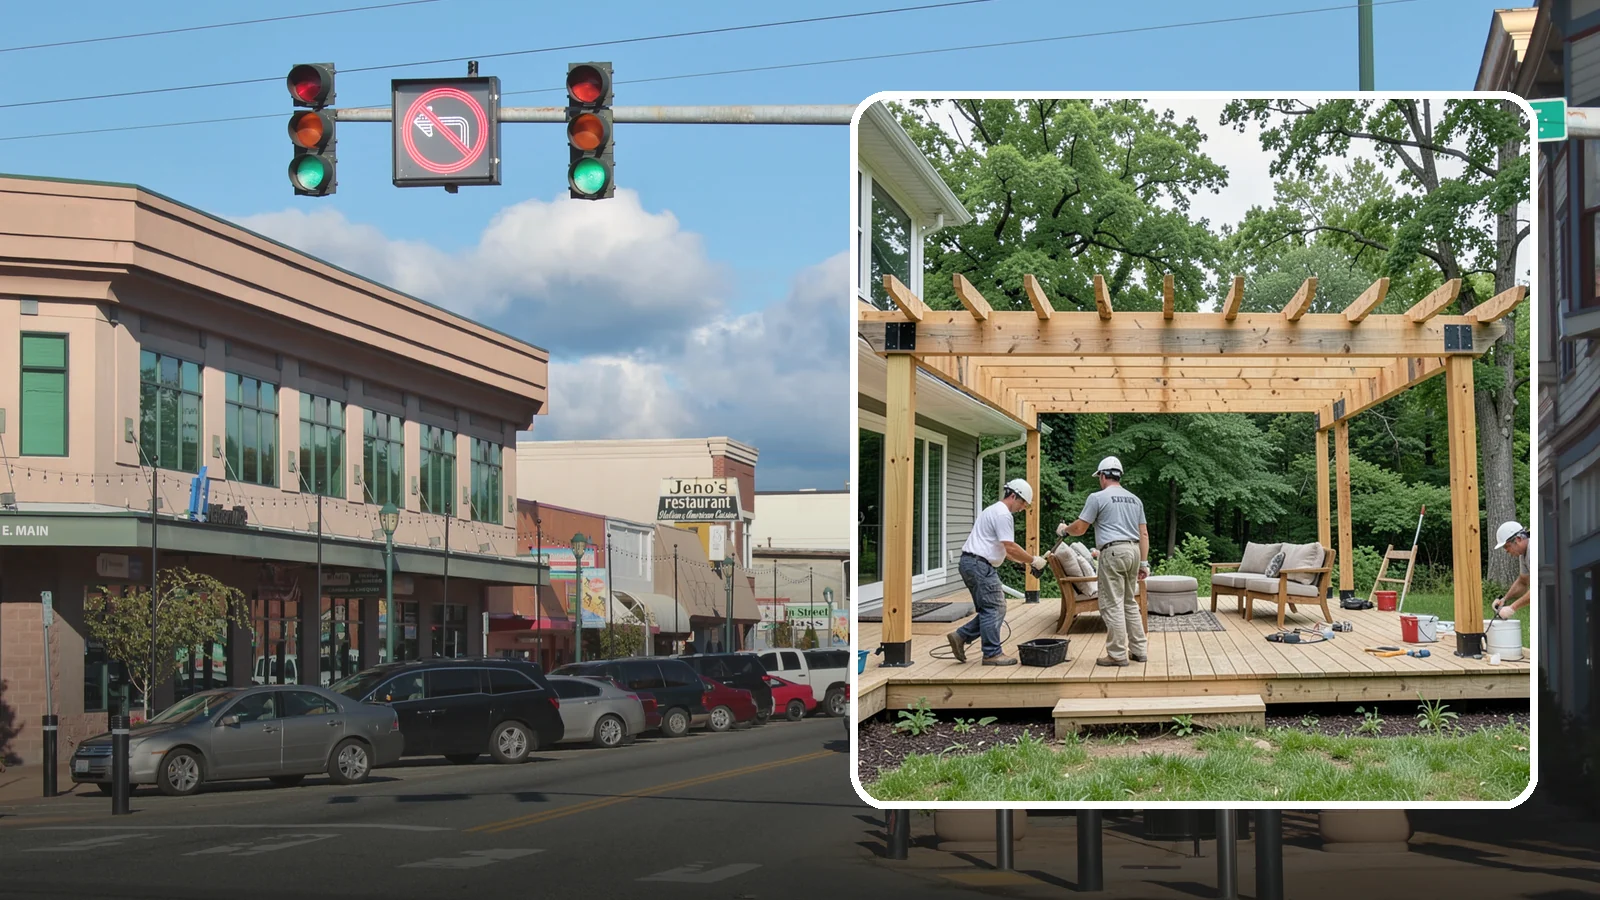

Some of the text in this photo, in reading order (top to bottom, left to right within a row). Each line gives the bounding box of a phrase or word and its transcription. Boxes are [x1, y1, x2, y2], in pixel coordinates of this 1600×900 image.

[669, 480, 728, 495] Jeno's
[665, 496, 731, 509] restaurant
[658, 509, 681, 520] Italian
[685, 509, 715, 520] American
[714, 509, 738, 520] Cuisine
[2, 525, 49, 536] E. MAIN
[797, 607, 828, 617] Street
[790, 618, 824, 627] lass
